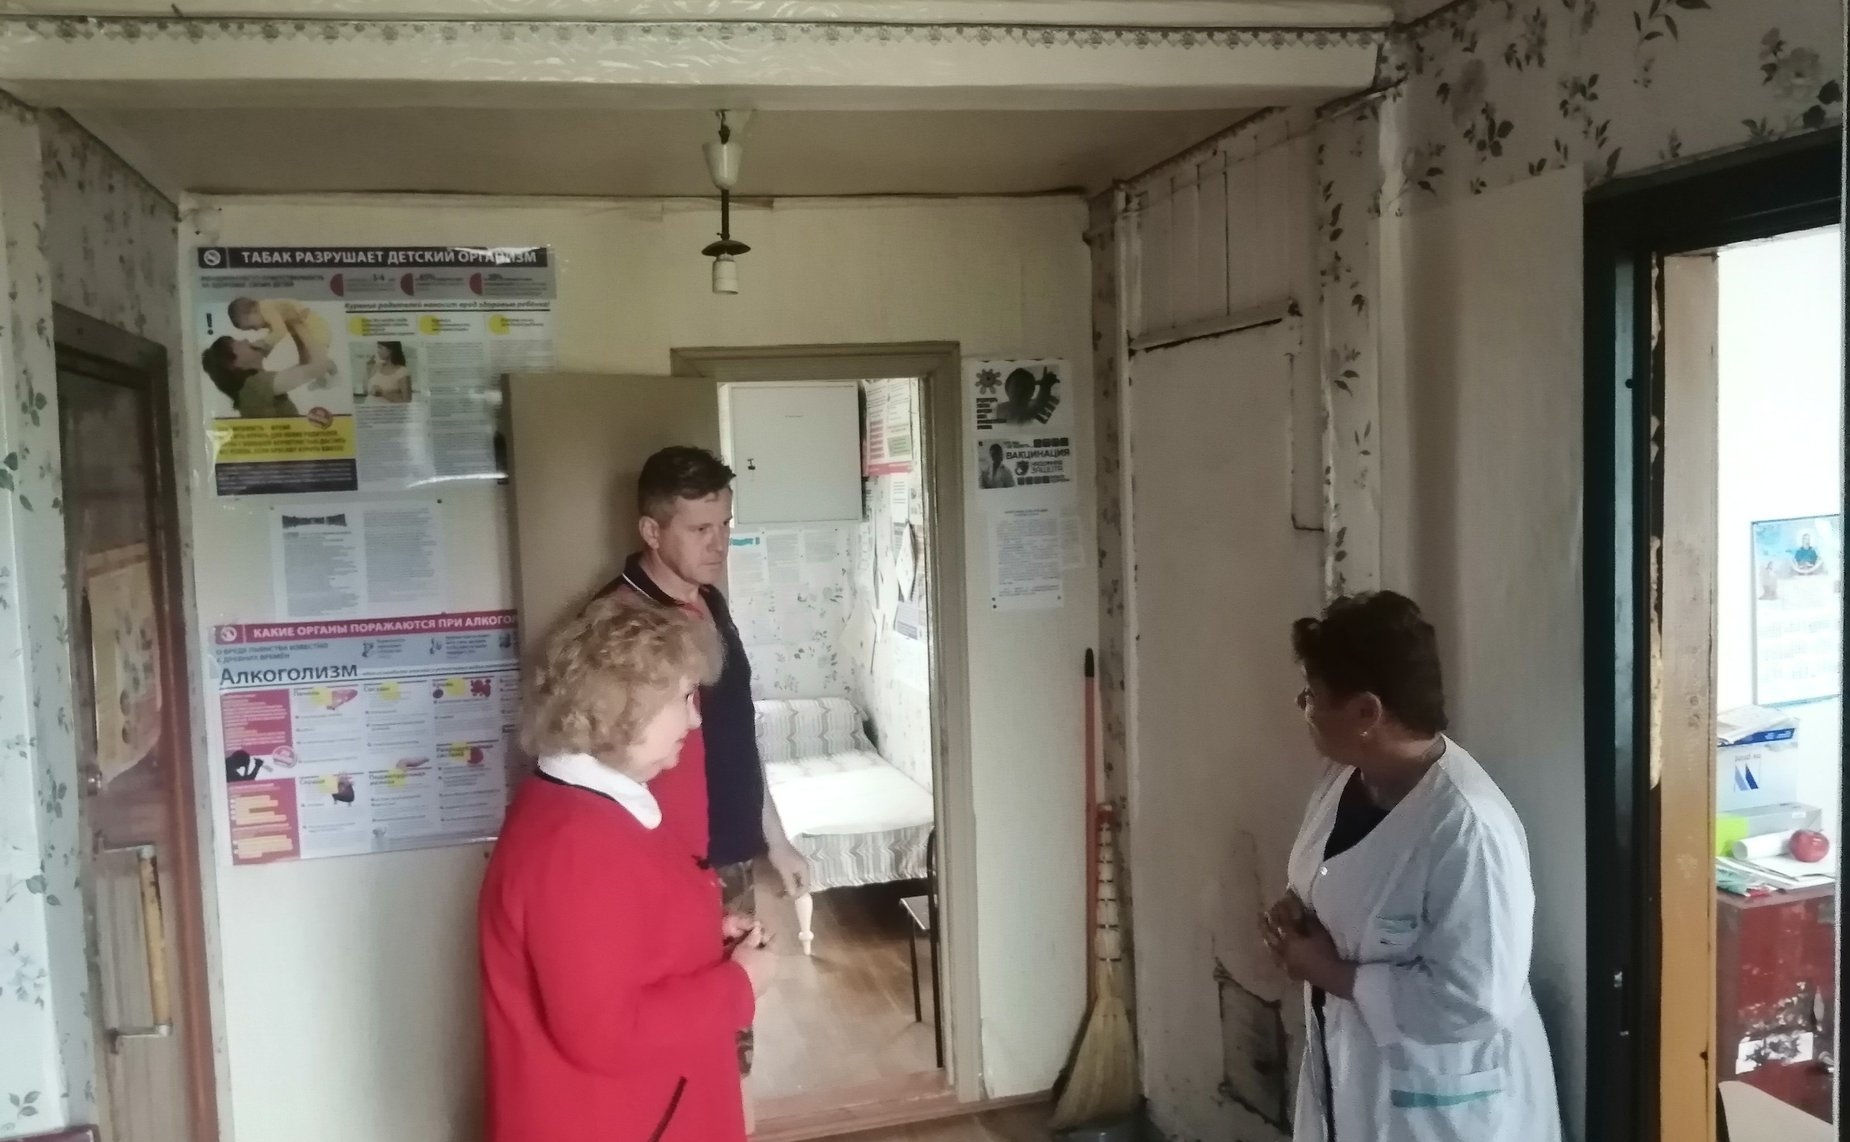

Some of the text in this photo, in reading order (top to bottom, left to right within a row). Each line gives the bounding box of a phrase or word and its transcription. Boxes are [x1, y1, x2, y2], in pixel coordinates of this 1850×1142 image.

[241, 251, 293, 264] ТАБАК
[295, 251, 384, 263] РАЗРУШАЕТ
[387, 250, 454, 264] ДЕТСКИЙ
[1006, 448, 1070, 459] ВАКЦИНАЦИЯ
[253, 627, 295, 638] КАКИЕ
[296, 624, 348, 636] ОРГАНЫ
[350, 619, 436, 633] ПОРАЖАЮТСЯ
[438, 618, 462, 628] ПРИ
[220, 664, 358, 685] Алкоголизм
